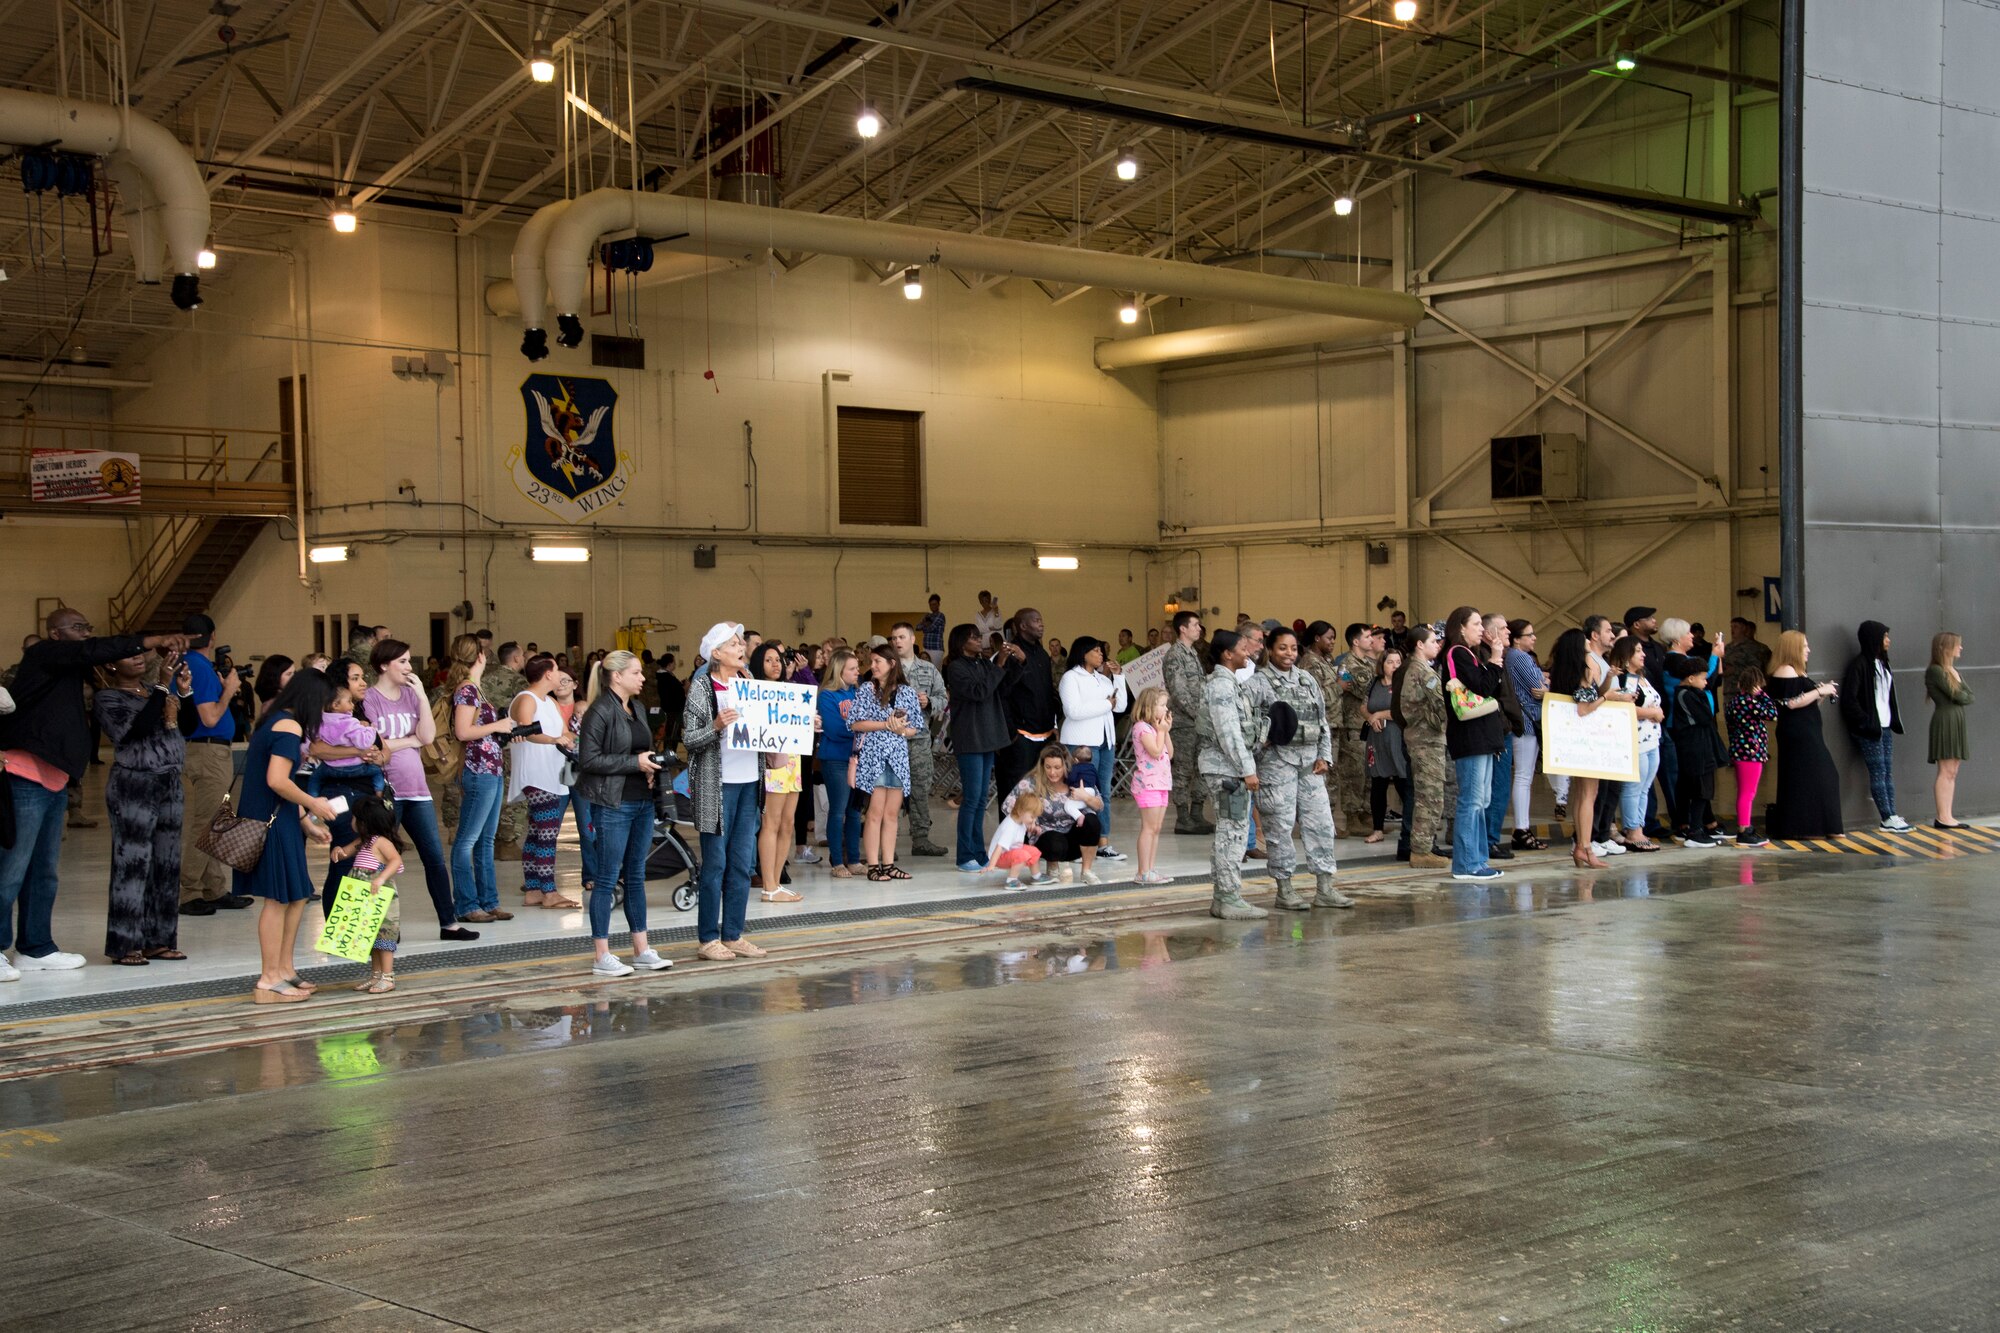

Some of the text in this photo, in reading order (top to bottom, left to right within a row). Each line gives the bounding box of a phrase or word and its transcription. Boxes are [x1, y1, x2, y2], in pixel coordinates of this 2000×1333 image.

[65, 458, 88, 469] HEROES
[576, 475, 627, 513] WING
[1125, 647, 1166, 674] WELCOME
[1139, 658, 1162, 675] HOM
[734, 680, 795, 702] Welcome
[1135, 668, 1161, 688] KRIST
[377, 712, 417, 740] PIN
[767, 702, 811, 726] Home
[732, 722, 788, 752] McKay
[323, 890, 352, 941] DADDY
[336, 888, 371, 957] BIRTHDAY
[363, 897, 386, 943] HAPPY
